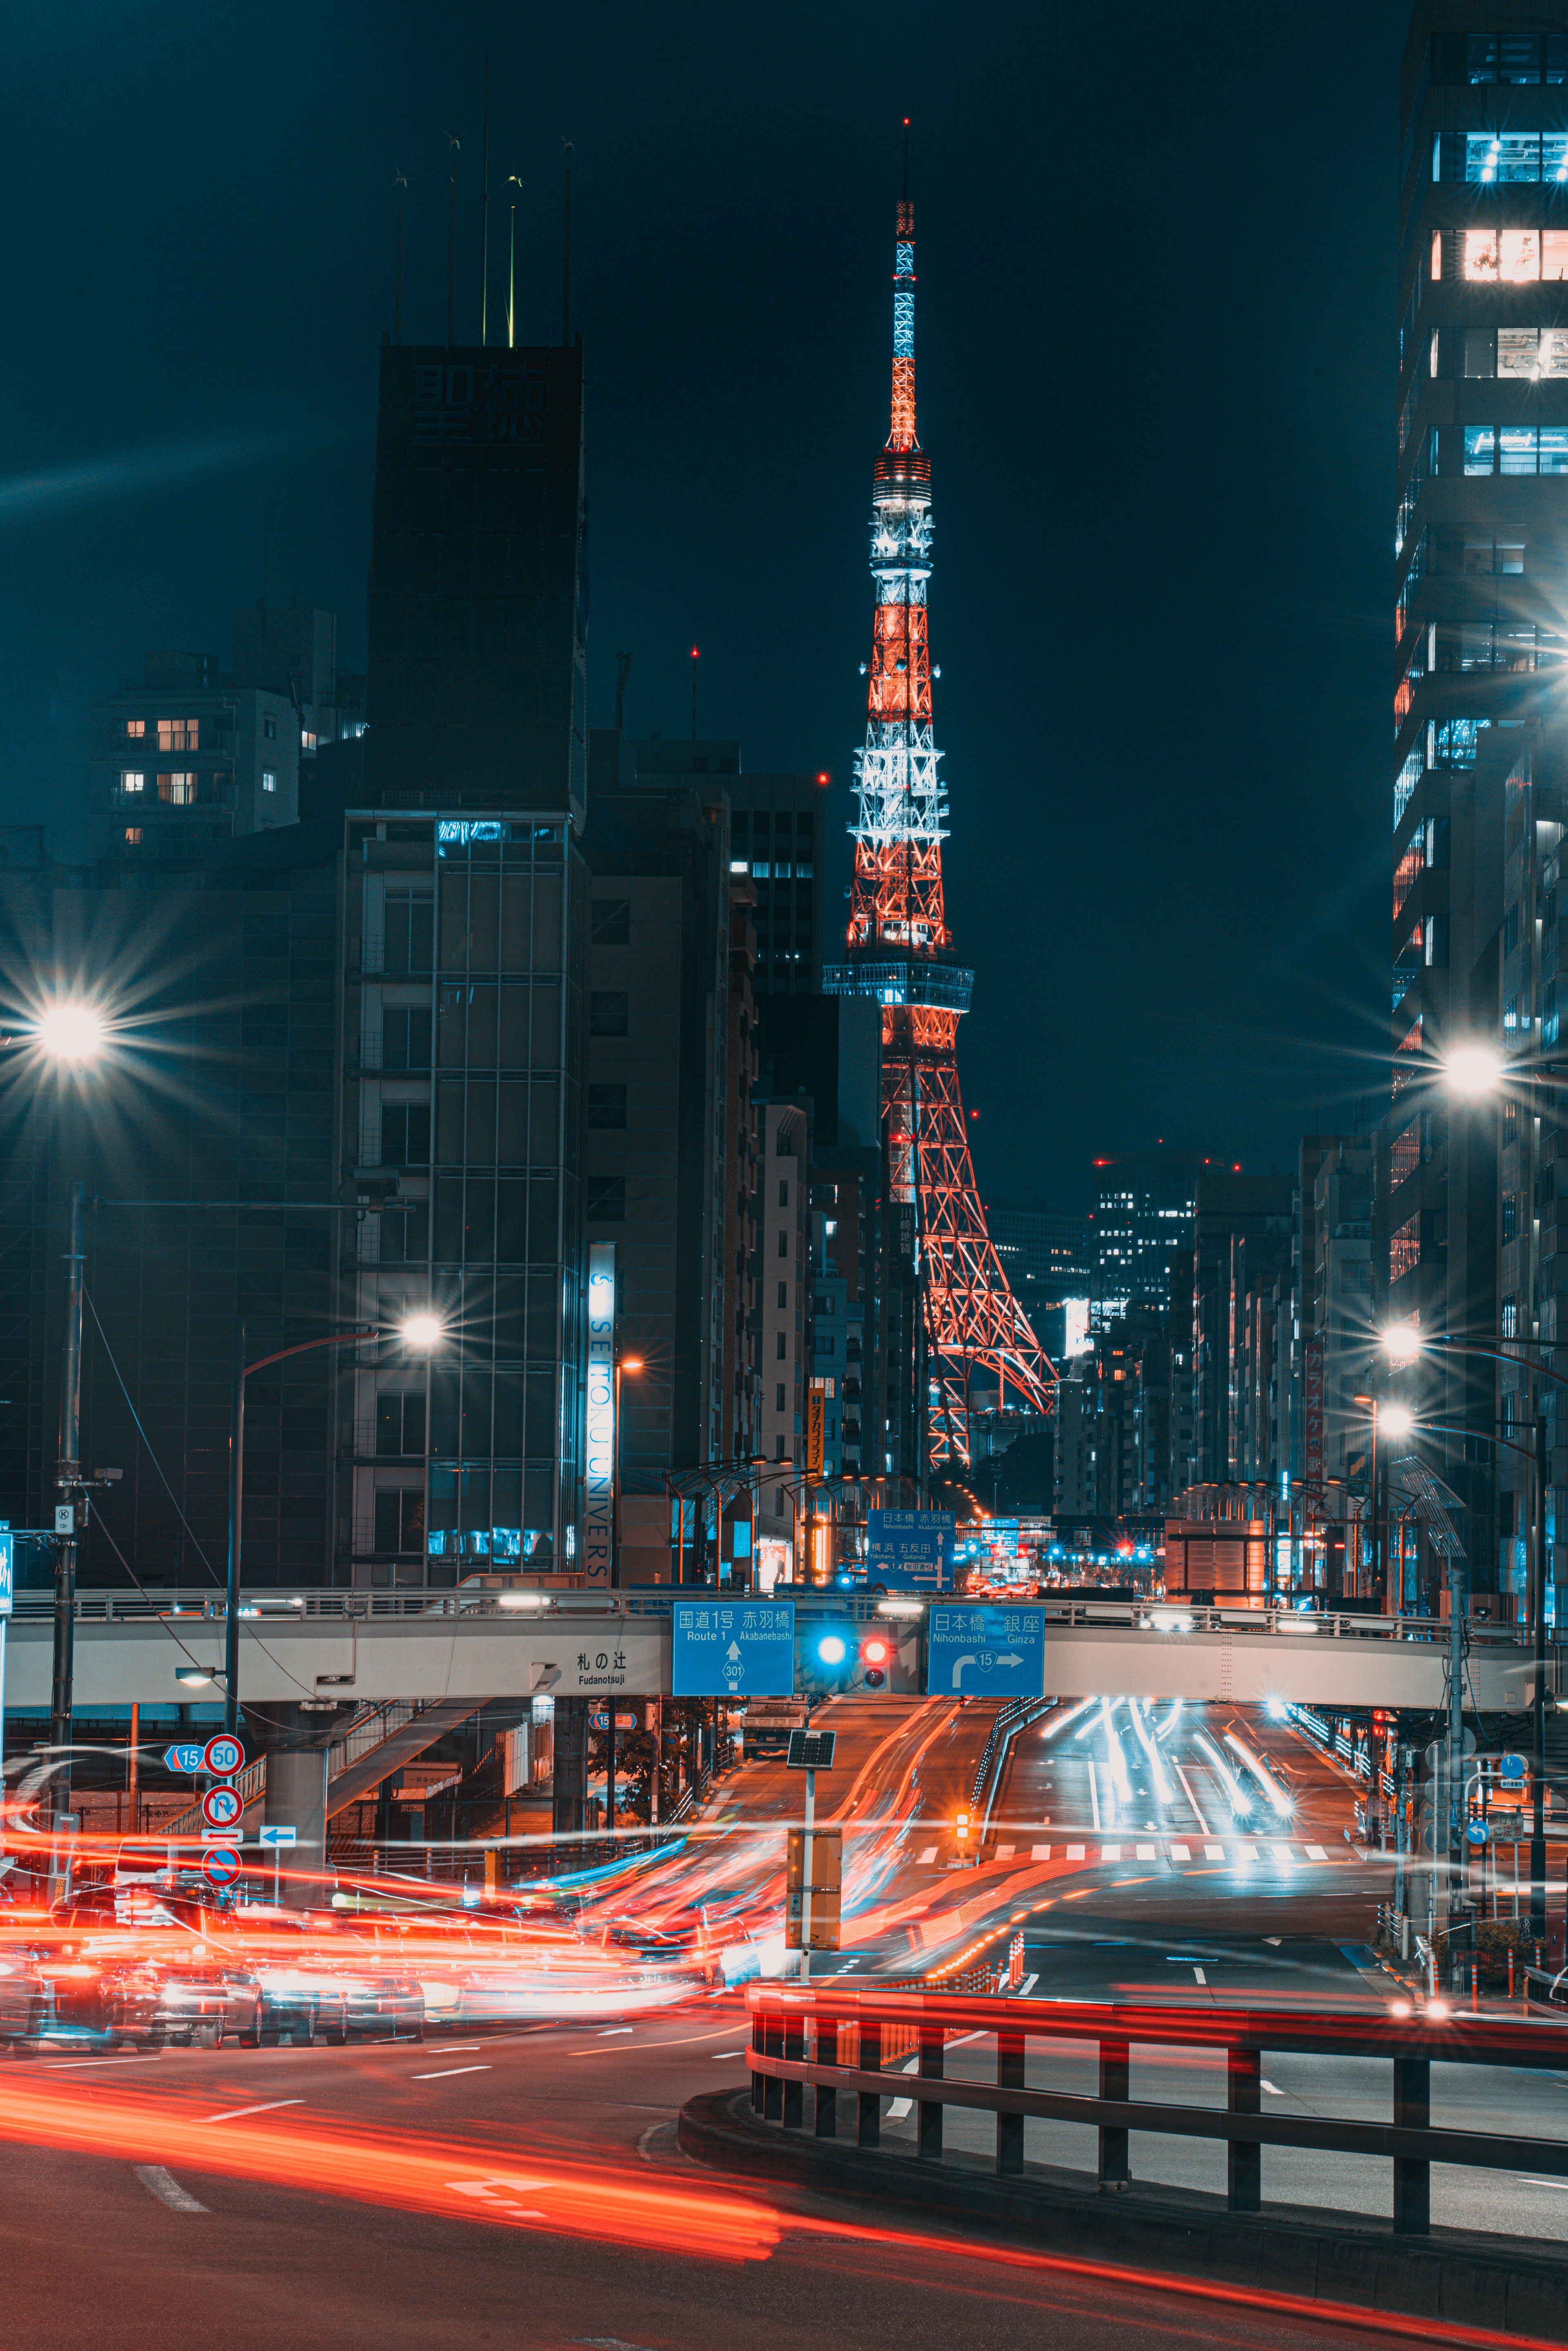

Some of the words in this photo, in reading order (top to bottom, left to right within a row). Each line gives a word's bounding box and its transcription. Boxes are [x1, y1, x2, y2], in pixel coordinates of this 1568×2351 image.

[590, 1320, 611, 1444] SEITOKU
[1308, 1350, 1322, 1433] カラオケ
[1307, 1456, 1321, 1515] 歌広場
[883, 1513, 914, 1523] 日本橋
[920, 1514, 951, 1524] 赤羽橋
[871, 1543, 894, 1553] 横浜
[899, 1543, 930, 1553] 五反田
[679, 1610, 734, 1629] 国道1号
[742, 1610, 790, 1629] 赤羽橋
[935, 1613, 985, 1631] 日本橋
[1003, 1615, 1040, 1632] 銀座
[687, 1631, 717, 1640] Route
[721, 1631, 726, 1640] 1
[740, 1631, 792, 1640] Akabanebashi
[933, 1633, 986, 1643] Nihonbashi
[1007, 1634, 1035, 1644] Ginza
[577, 1651, 626, 1671] 札の辻
[980, 1654, 992, 1666] 15
[726, 1666, 742, 1676] 301
[579, 1674, 625, 1685] Fudanotsuji
[599, 1716, 609, 1725] 15
[182, 1750, 198, 1767] 15
[213, 1747, 236, 1766] 50
[1488, 1814, 1519, 1825] 歩行者
[1494, 1826, 1522, 1836] に注意
